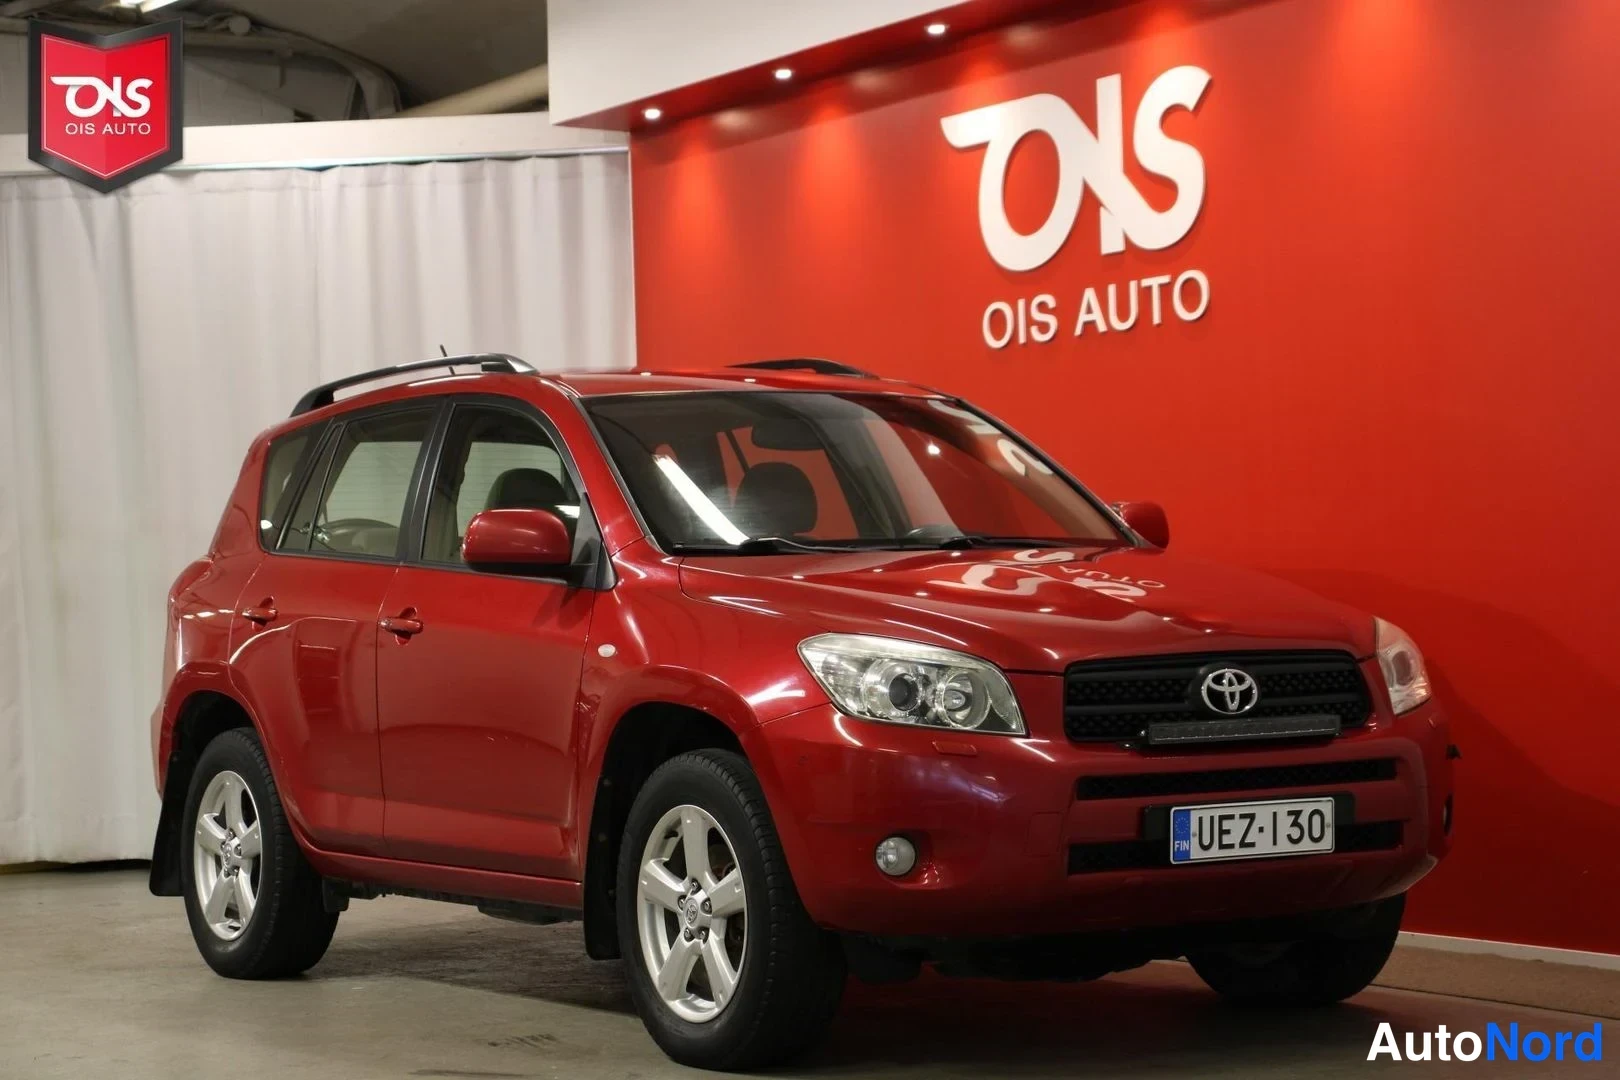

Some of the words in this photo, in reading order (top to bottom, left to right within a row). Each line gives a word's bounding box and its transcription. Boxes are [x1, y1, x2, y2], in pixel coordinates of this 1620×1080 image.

[982, 294, 1058, 349] OIS
[1074, 269, 1210, 336] AUTO
[1174, 839, 1190, 851] FIN
